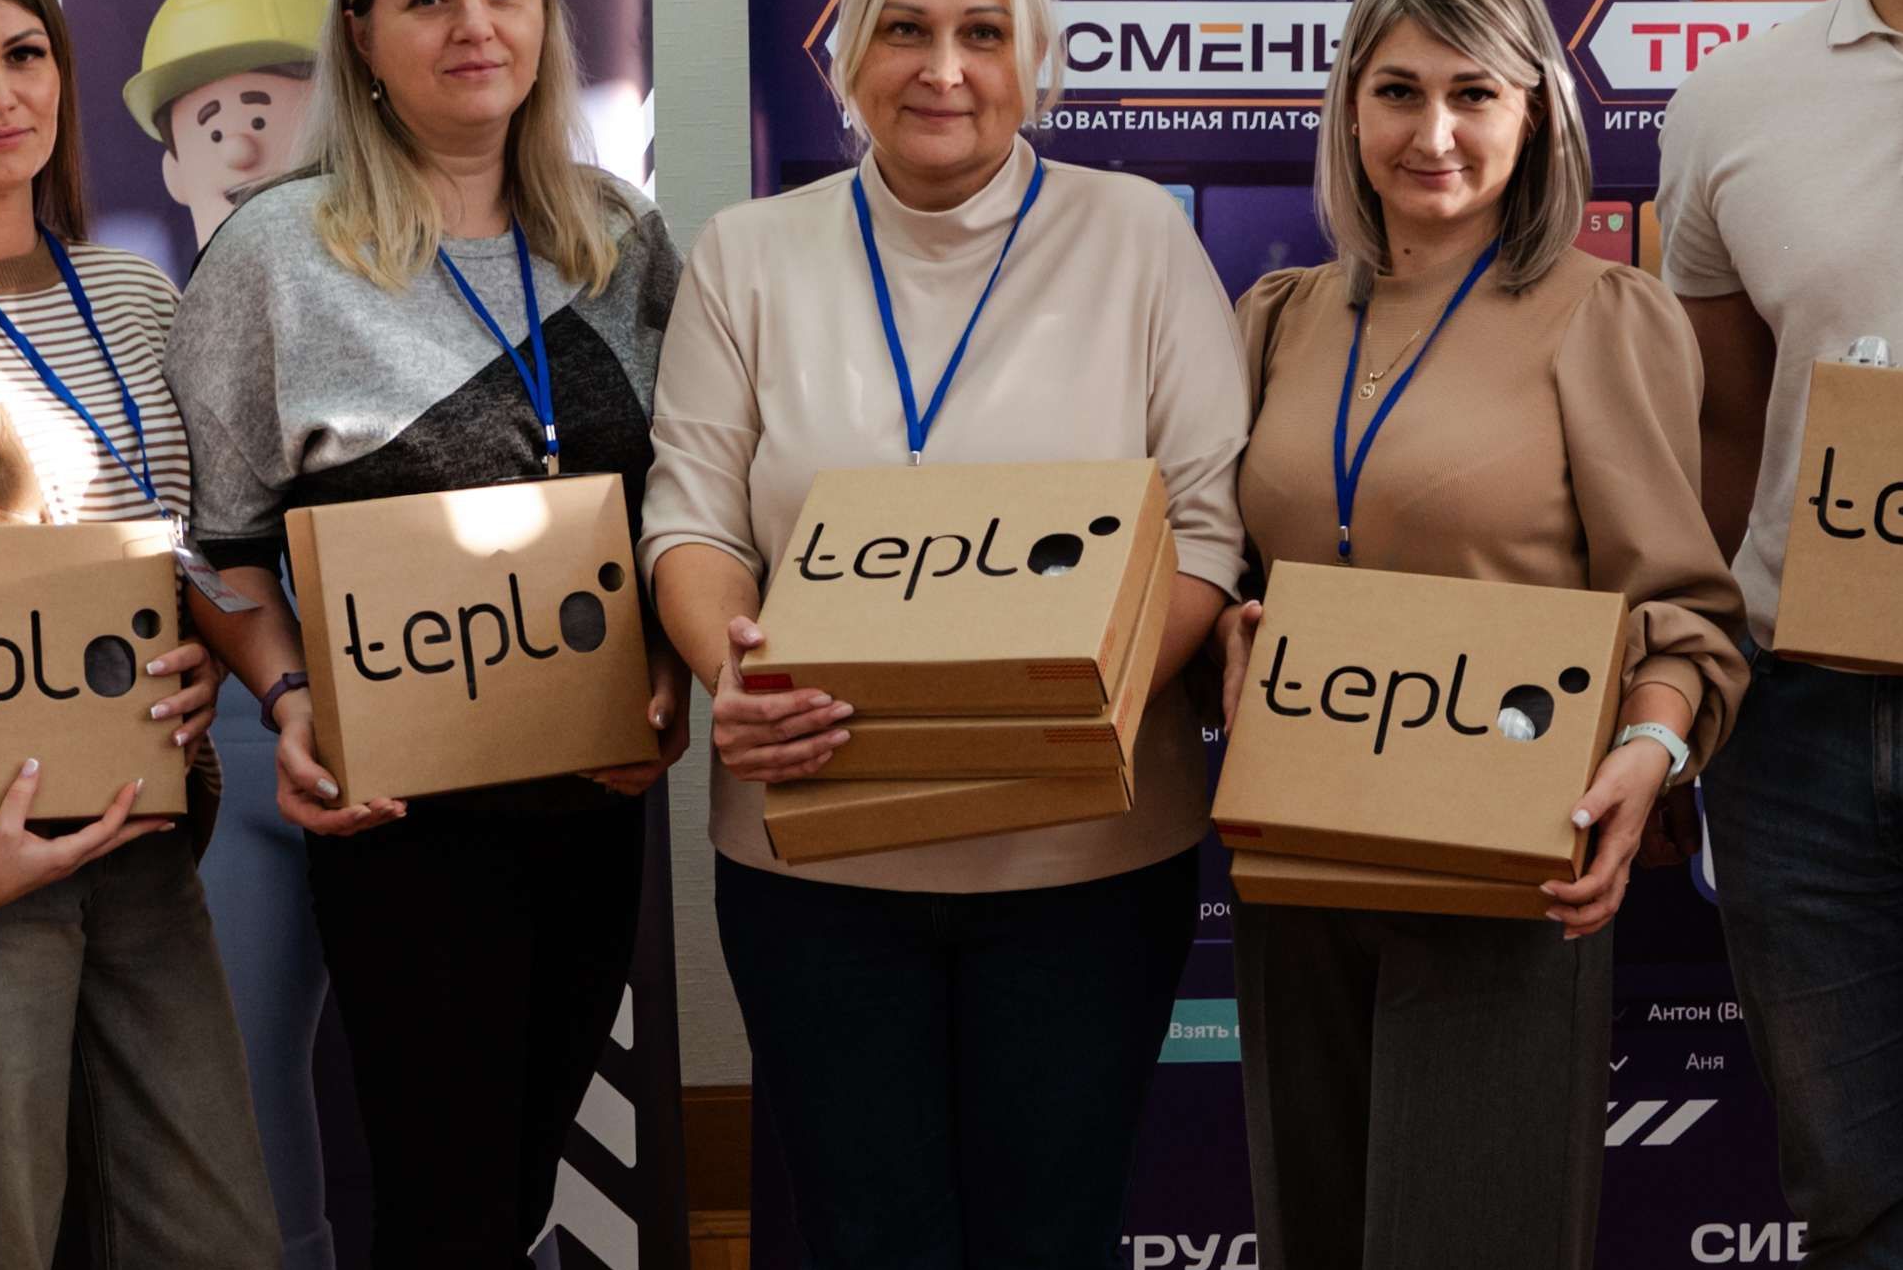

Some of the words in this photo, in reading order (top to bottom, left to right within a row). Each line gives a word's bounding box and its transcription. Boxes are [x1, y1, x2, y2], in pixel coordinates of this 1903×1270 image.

[1590, 215, 1601, 231] 5
[1647, 1003, 1711, 1021] Антон
[1169, 1023, 1229, 1040] Взять
[1685, 1052, 1724, 1070] Аня
